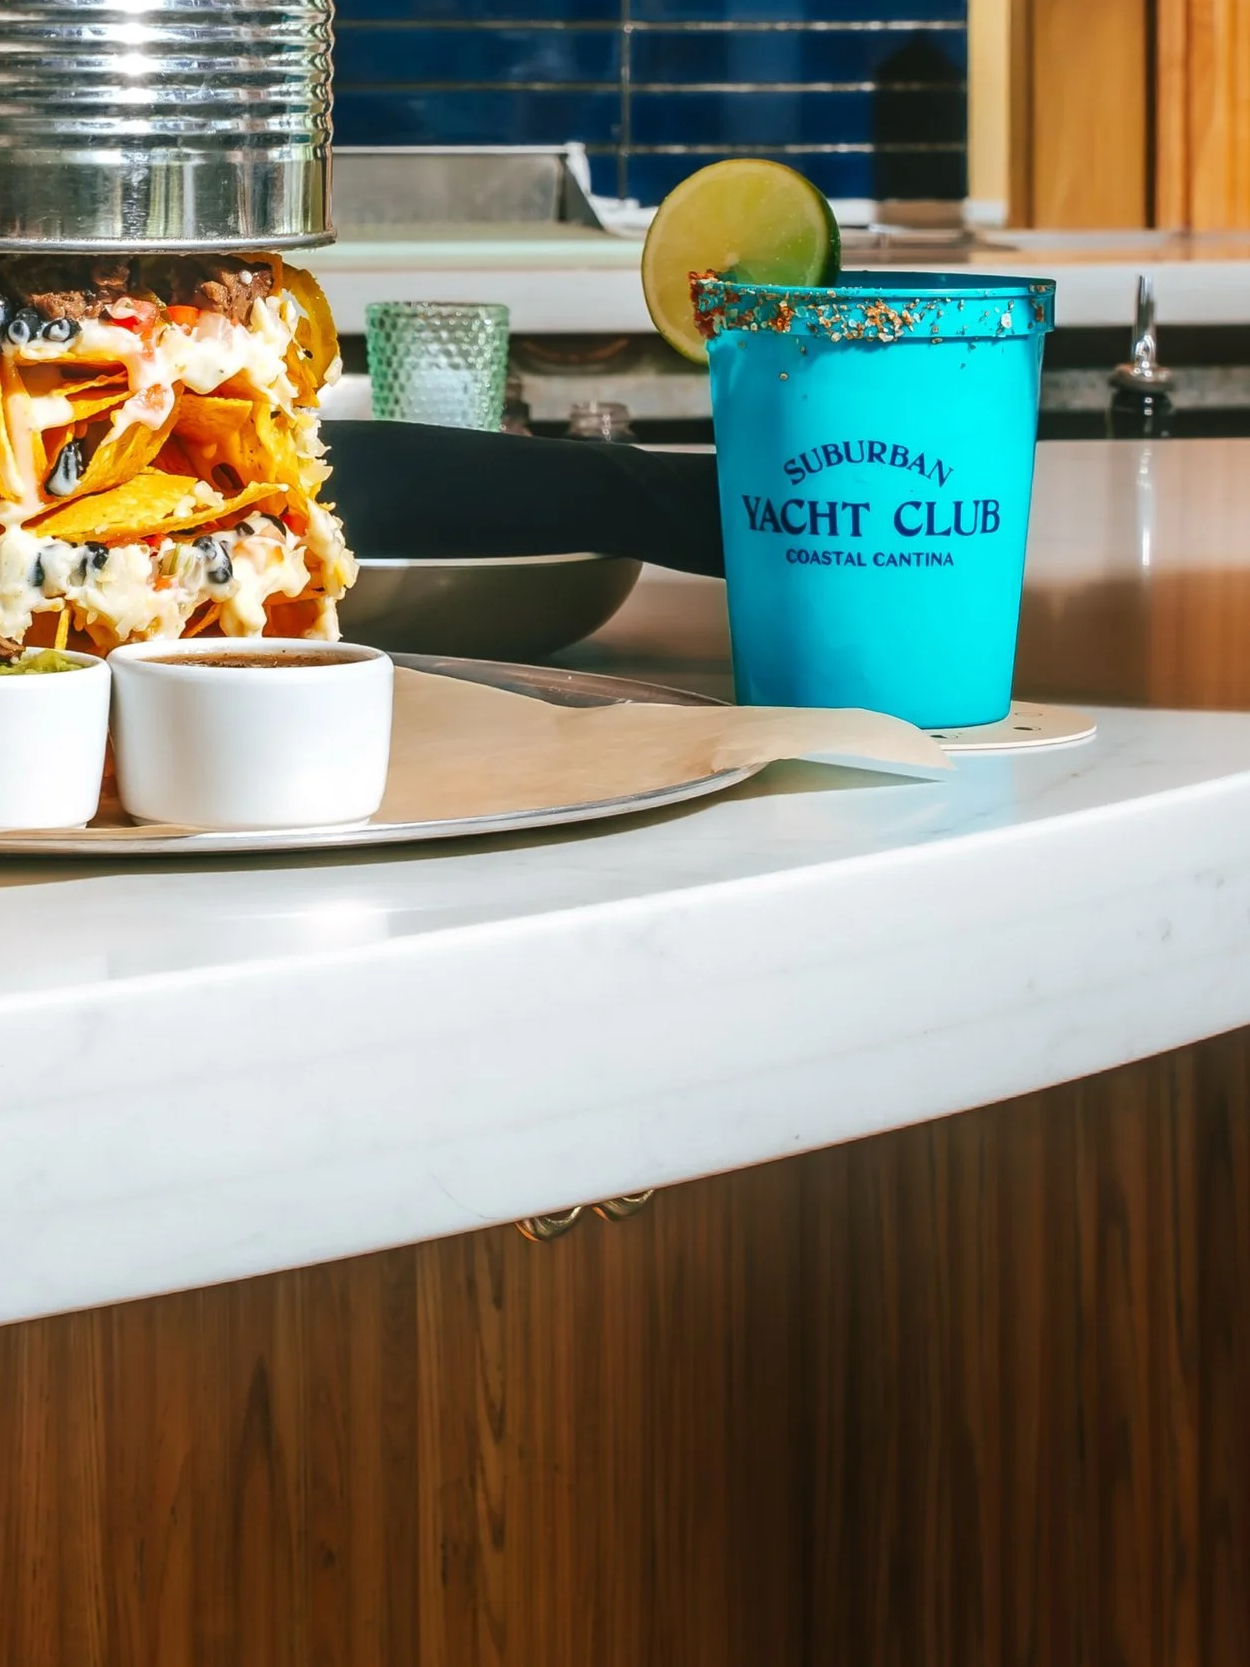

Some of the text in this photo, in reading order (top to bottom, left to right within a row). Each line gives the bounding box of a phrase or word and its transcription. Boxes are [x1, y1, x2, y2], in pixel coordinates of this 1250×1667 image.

[783, 440, 954, 488] SUBURBAN
[742, 495, 1000, 537] YACHT CLUB
[786, 549, 954, 567] COASTAL CANTINA
